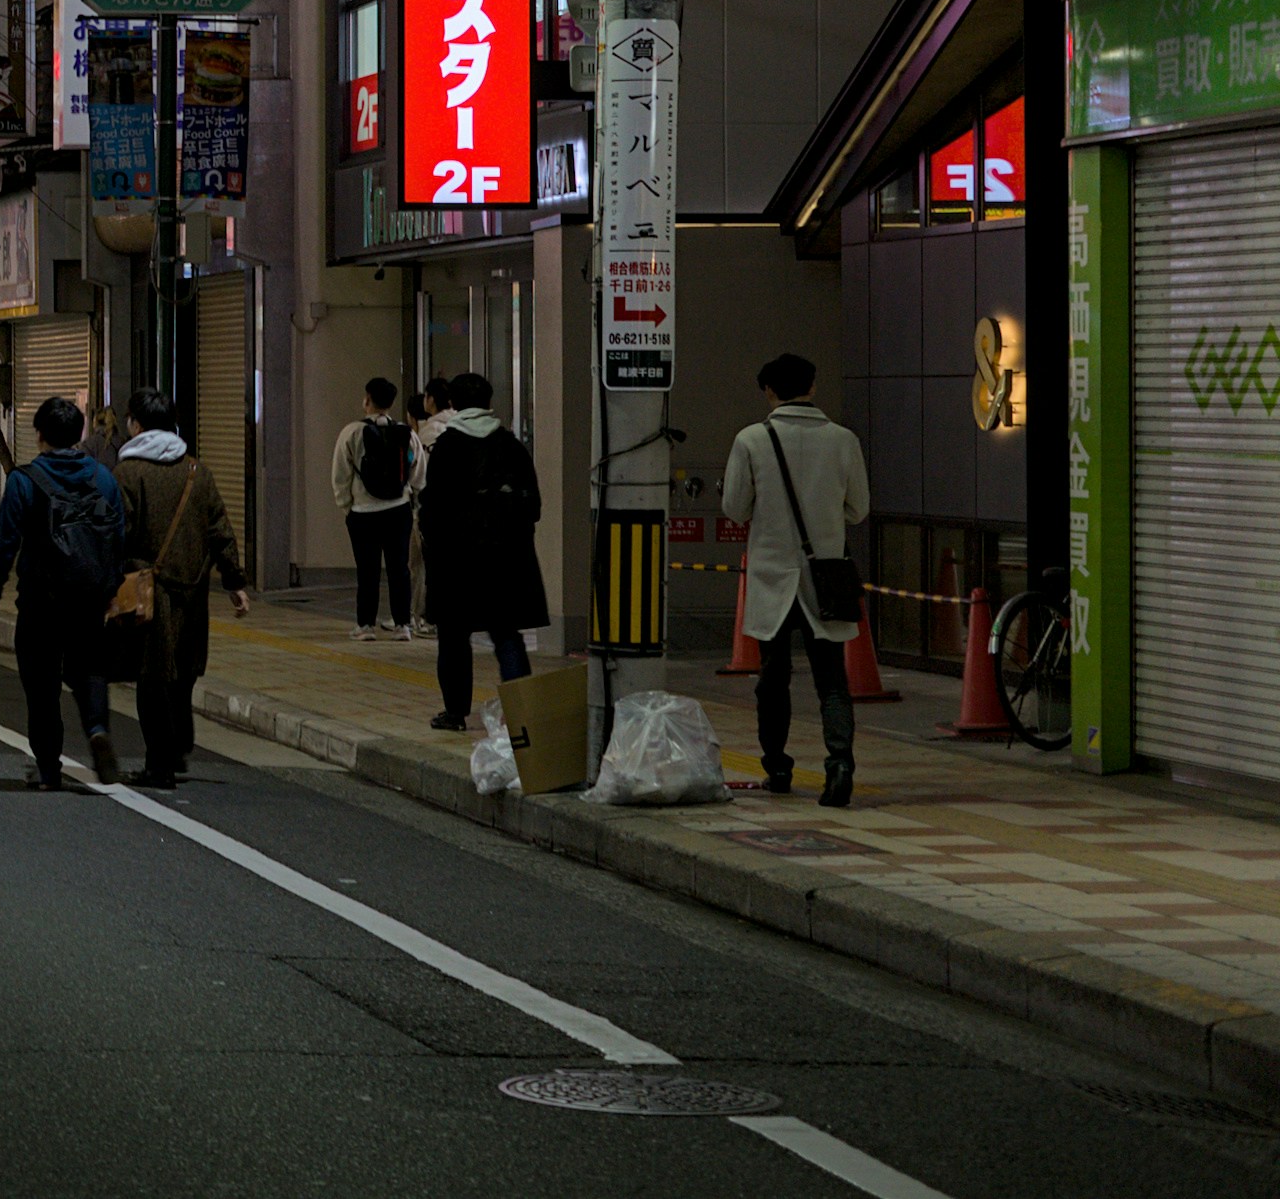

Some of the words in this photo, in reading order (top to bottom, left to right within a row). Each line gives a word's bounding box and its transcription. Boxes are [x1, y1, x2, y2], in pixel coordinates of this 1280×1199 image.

[631, 38, 656, 63] 質
[357, 85, 379, 144] 2F
[6, 120, 24, 132] Inc.
[184, 115, 248, 129] フードホール
[184, 127, 212, 140] Food
[213, 128, 246, 140] Court
[432, 159, 501, 204] 2F
[609, 332, 671, 346] 06-6211-5188
